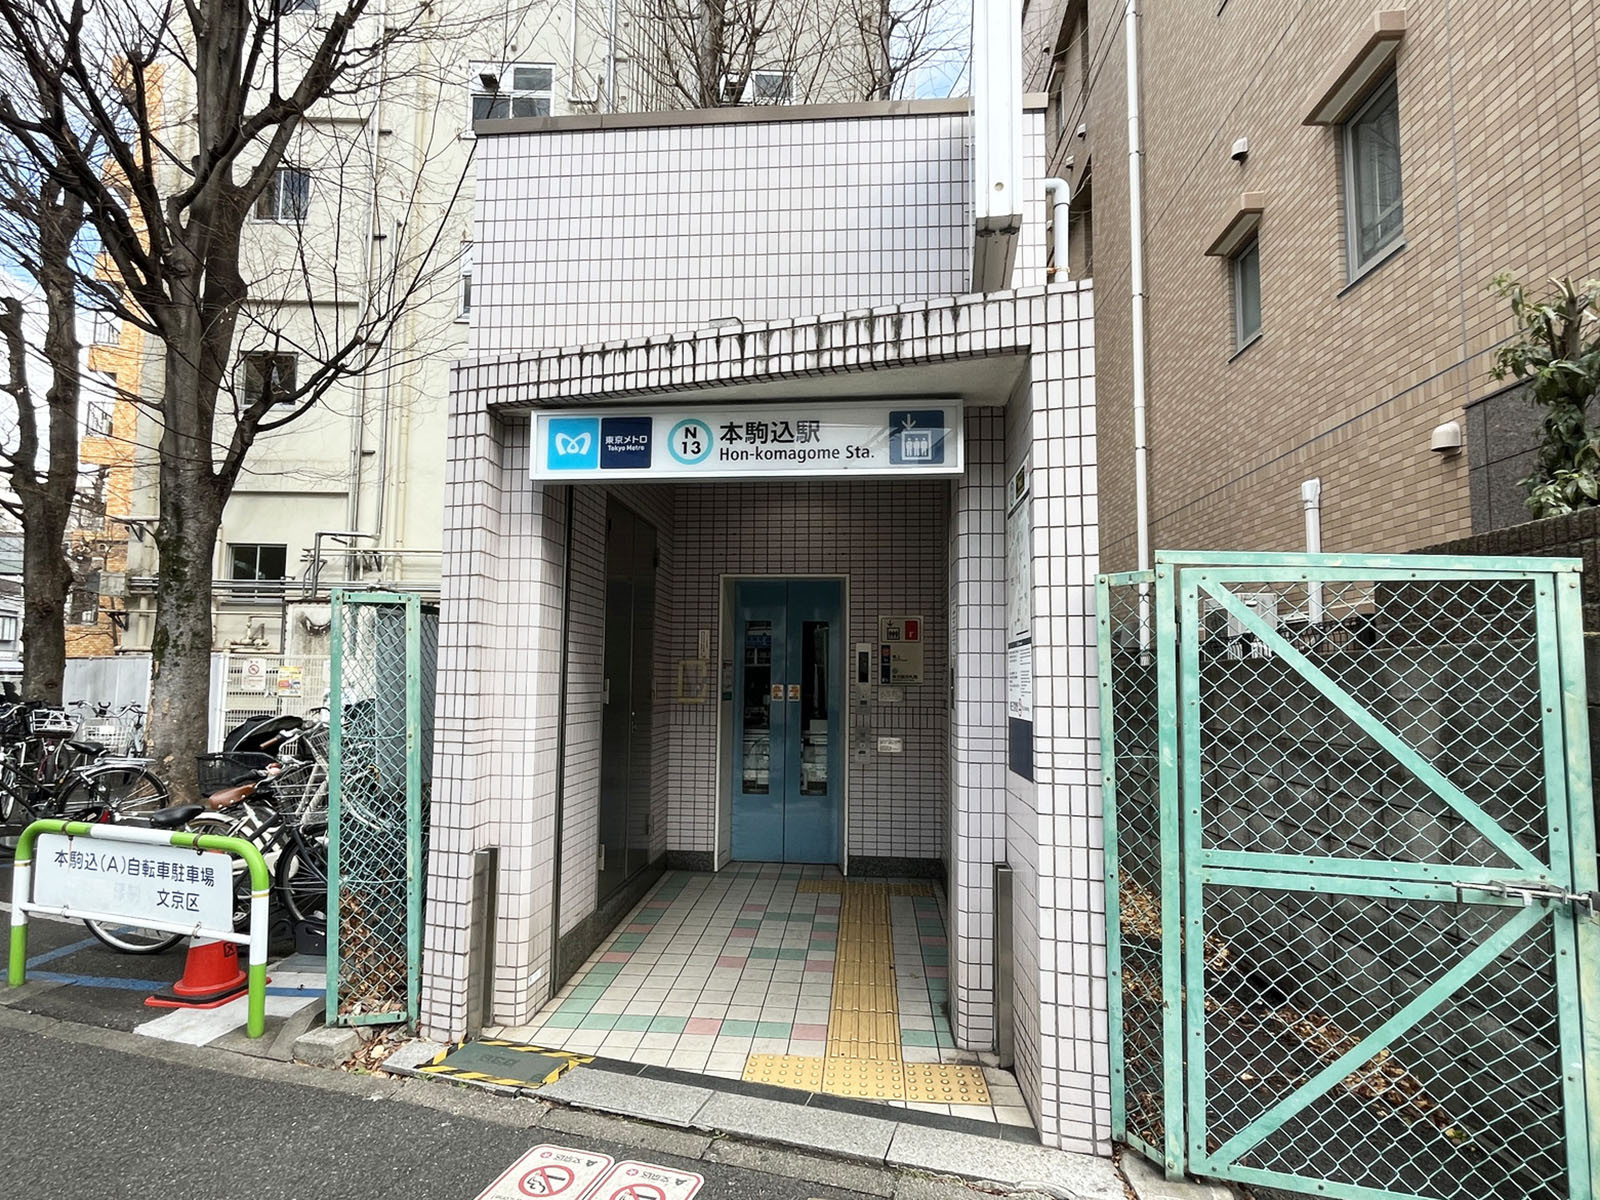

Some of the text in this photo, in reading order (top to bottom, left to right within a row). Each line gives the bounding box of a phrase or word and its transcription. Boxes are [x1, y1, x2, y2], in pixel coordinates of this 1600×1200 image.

[605, 435, 648, 444] 東京メトロ
[684, 427, 698, 439] N
[719, 420, 821, 445] 本駒込駅
[682, 441, 702, 455] 13
[719, 445, 875, 463] Hon-komagome Sta.
[54, 850, 215, 888] 本駒込(A)自転車駐車場
[156, 888, 200, 912] 文京区
